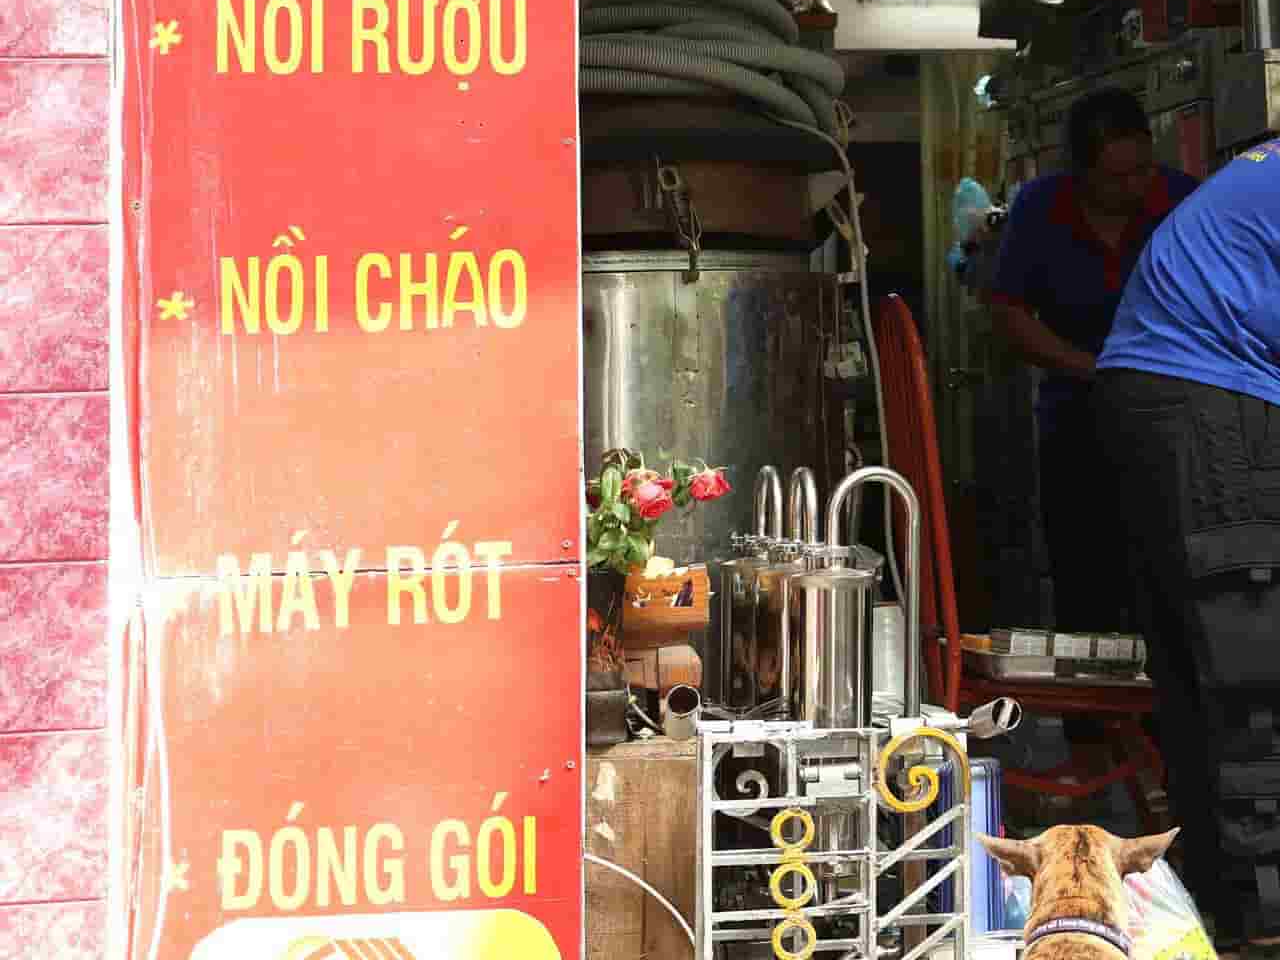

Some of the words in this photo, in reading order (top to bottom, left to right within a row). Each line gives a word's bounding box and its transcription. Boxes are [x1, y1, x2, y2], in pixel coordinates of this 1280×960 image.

[220, 225, 328, 335] NỒI
[355, 226, 527, 332] CHÁO
[214, 529, 361, 636] MÁY
[387, 521, 511, 625] RÓT
[217, 802, 402, 911] ĐÓNG
[430, 791, 538, 901] GÓI
